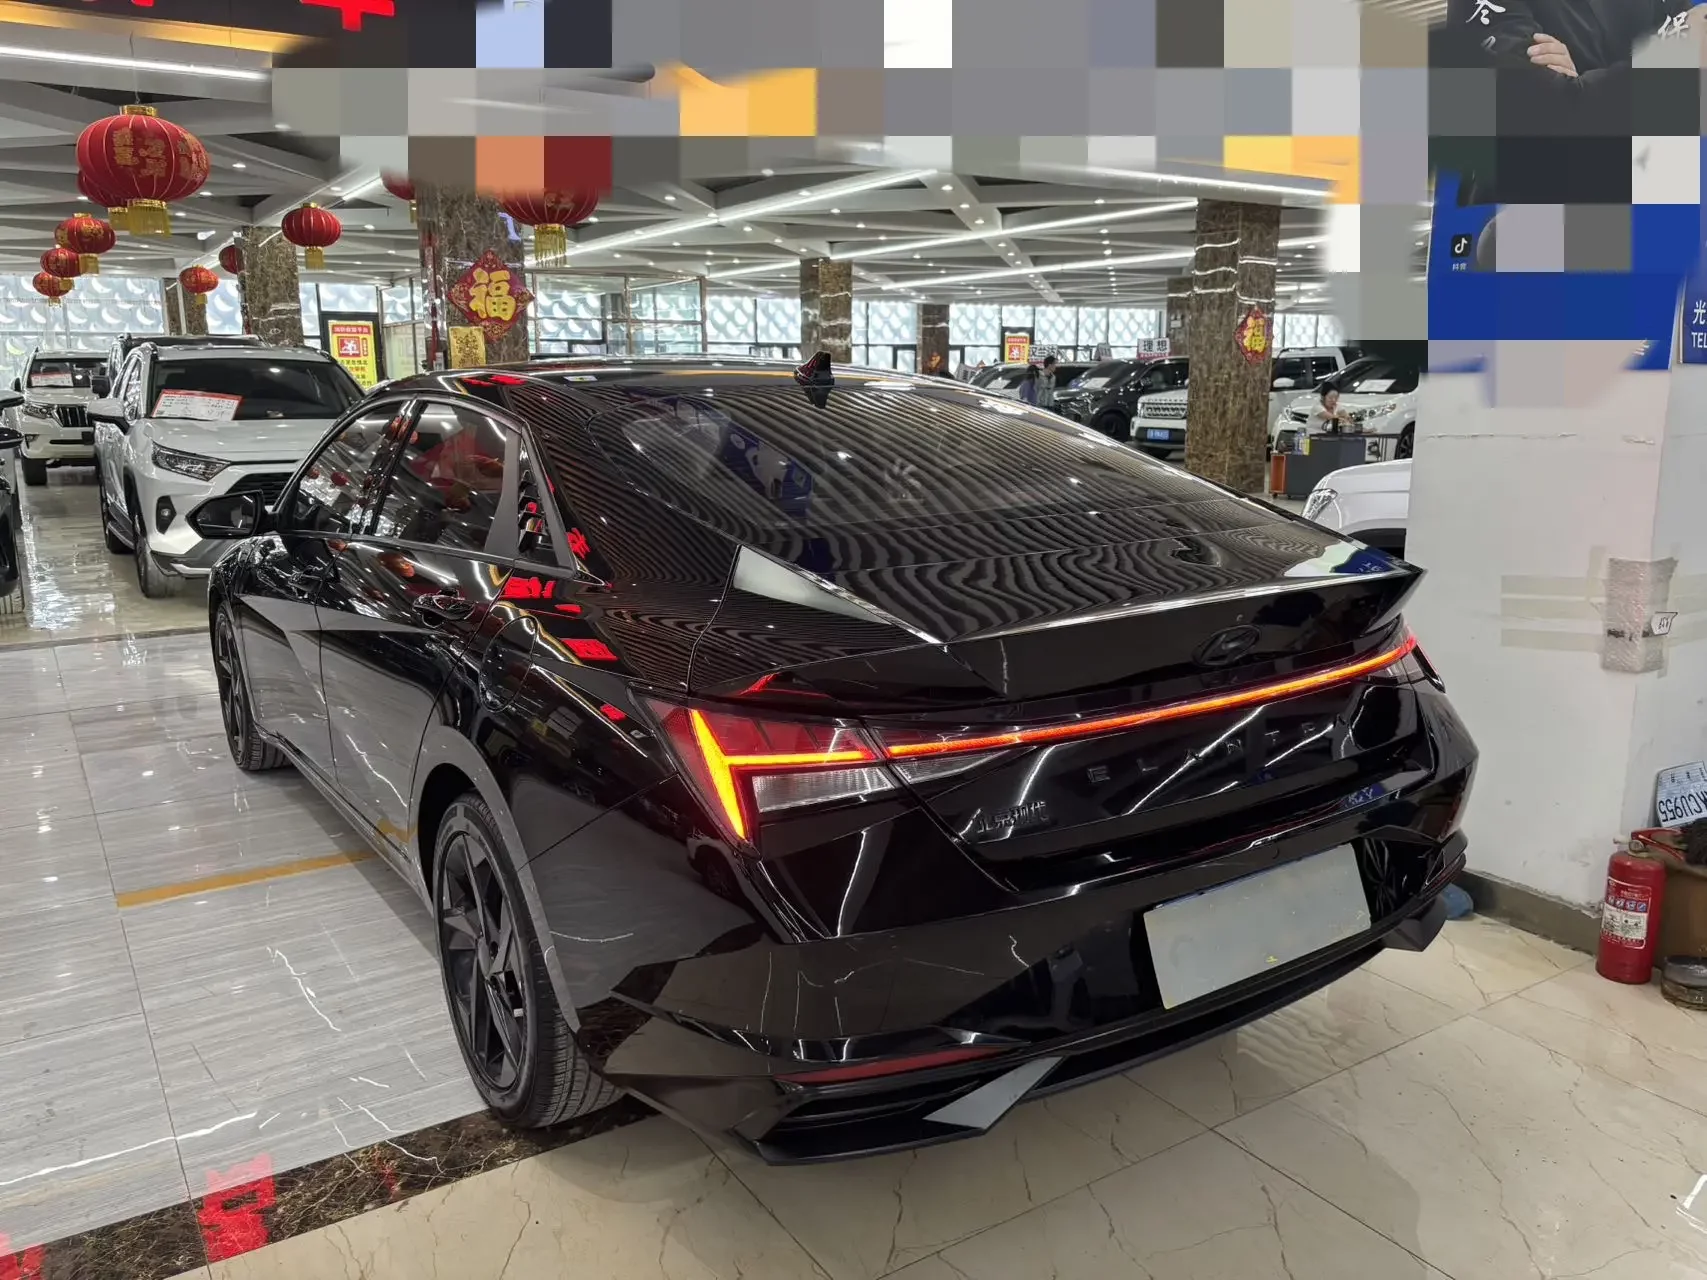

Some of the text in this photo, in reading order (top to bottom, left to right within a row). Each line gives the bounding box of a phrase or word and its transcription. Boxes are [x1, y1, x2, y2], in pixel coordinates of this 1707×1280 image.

[468, 267, 517, 322] 福
[1143, 339, 1168, 352] 理想
[1243, 315, 1267, 354] 福
[976, 800, 1049, 834] 北京现代
